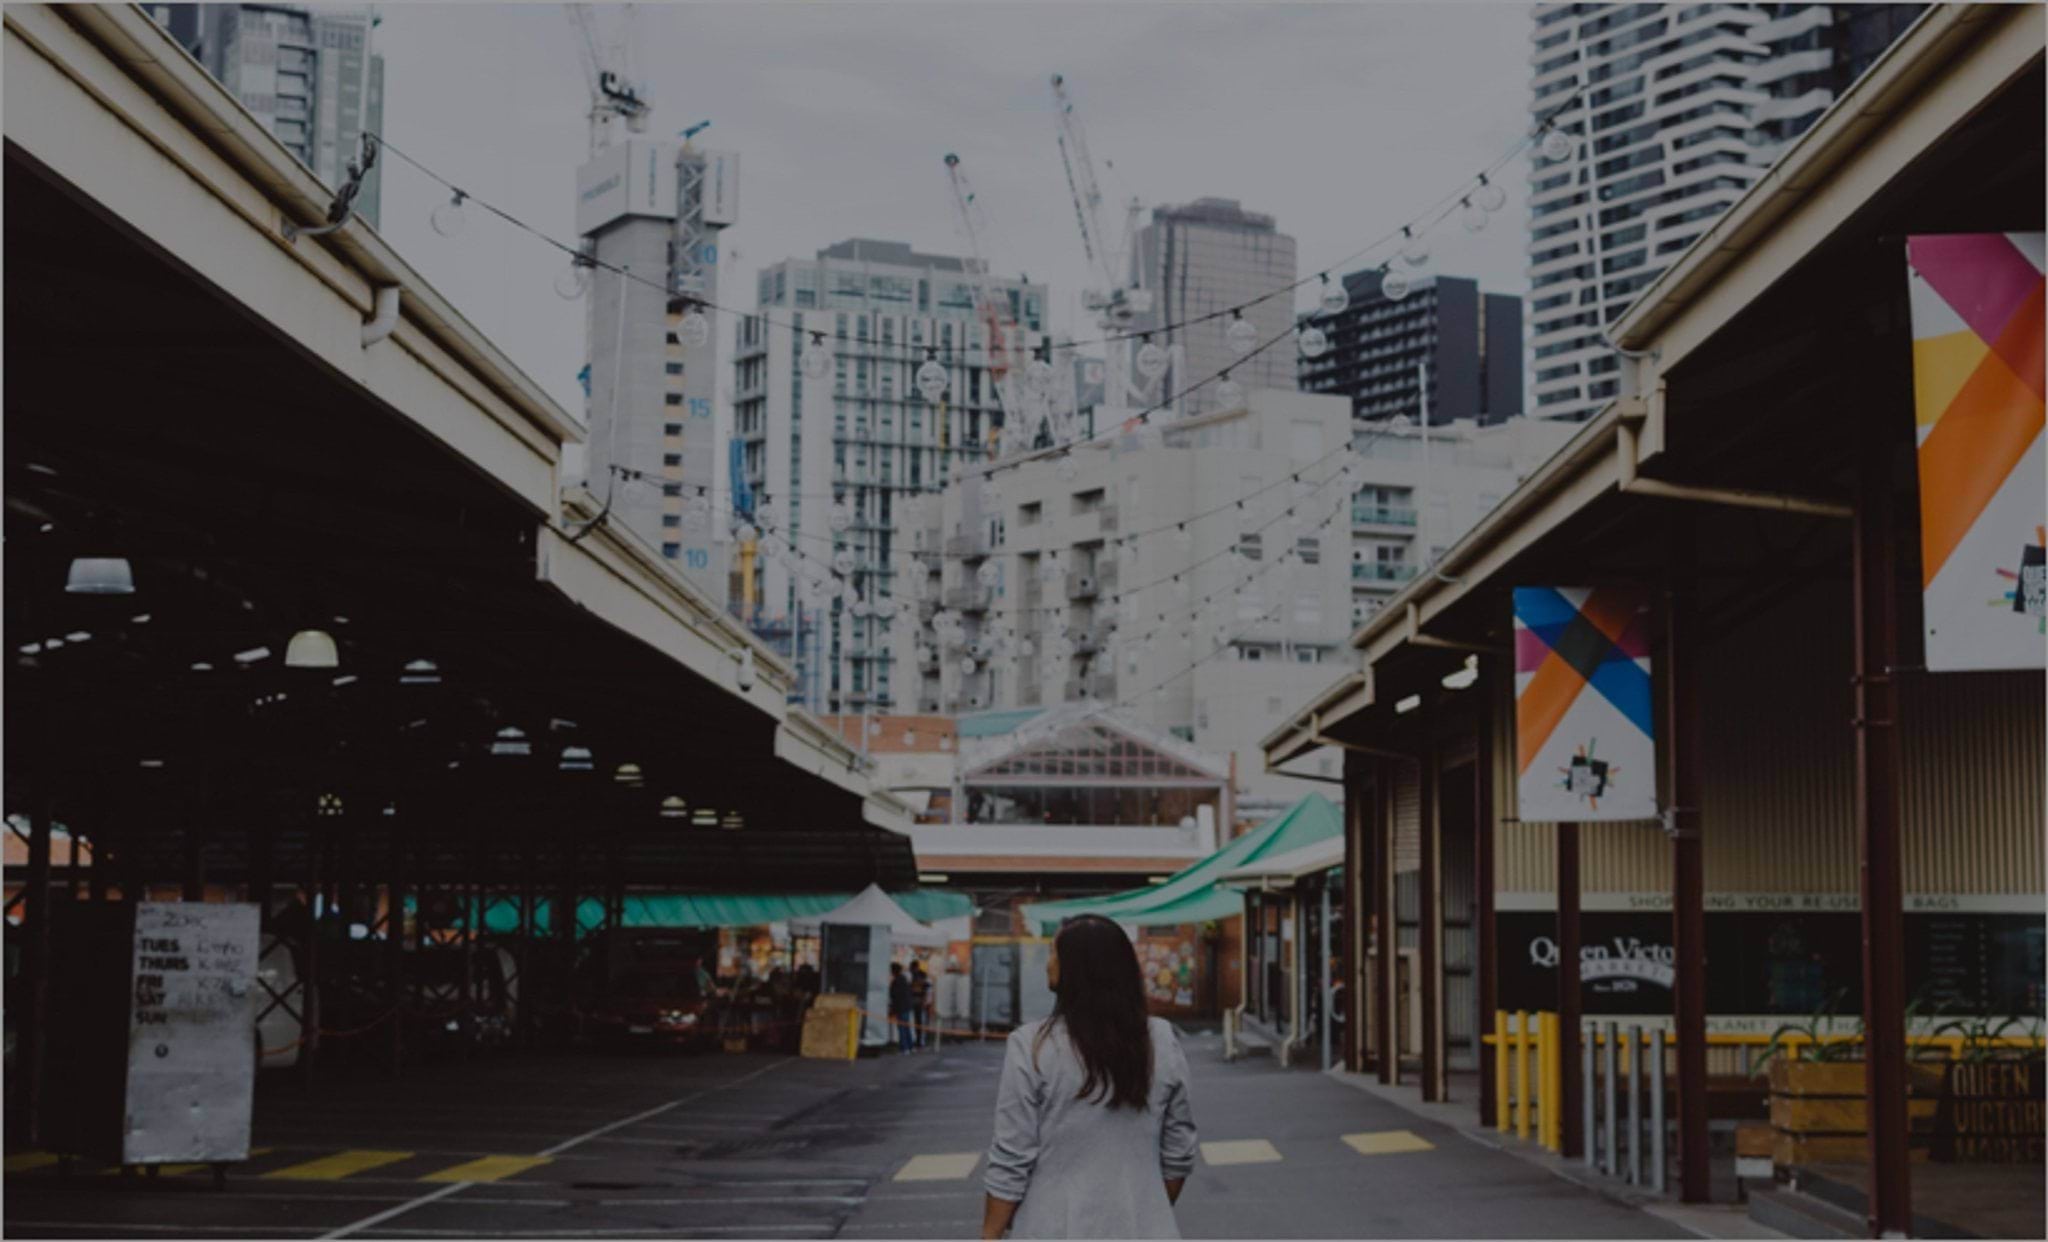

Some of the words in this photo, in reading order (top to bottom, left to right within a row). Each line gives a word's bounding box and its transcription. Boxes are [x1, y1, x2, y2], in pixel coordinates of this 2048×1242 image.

[690, 398, 710, 418] 15
[687, 548, 708, 568] 10
[1744, 896, 1794, 909] YOUR
[1912, 897, 1960, 910] BAGS
[141, 938, 180, 953] TUES
[1529, 936, 1610, 968] Quen
[1613, 936, 1676, 964] Victo
[140, 956, 189, 971] THURS
[137, 974, 164, 988] FRI
[136, 992, 166, 1005] SAT
[136, 1009, 168, 1024] SUN
[1951, 1062, 2031, 1096] QUEEN
[1951, 1100, 2046, 1134] VICTORI
[1951, 1136, 2046, 1162] MARKE
